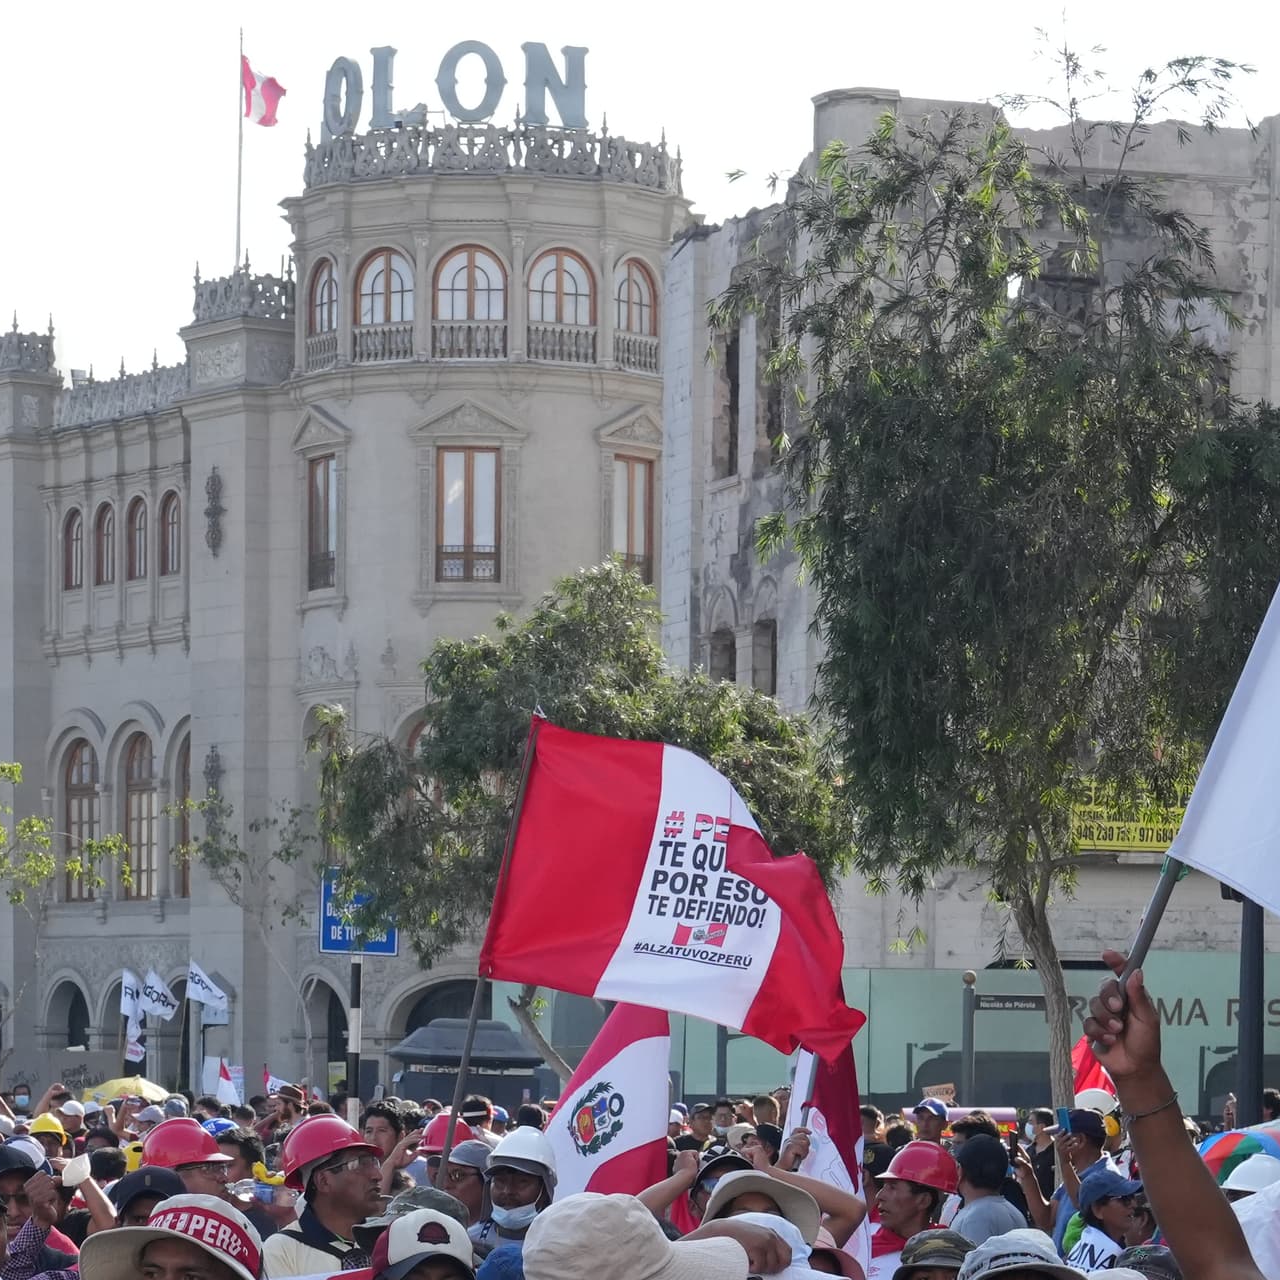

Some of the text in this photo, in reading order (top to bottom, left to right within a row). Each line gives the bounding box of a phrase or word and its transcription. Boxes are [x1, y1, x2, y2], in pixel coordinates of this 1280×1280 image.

[658, 841, 687, 868] TE
[650, 870, 708, 897] POR
[648, 894, 767, 928] TE DEFIENDO!
[331, 925, 343, 940] DE
[633, 942, 753, 967] #ALZATUVOZPERÚ
[980, 1001, 1003, 1009] Nicolás
